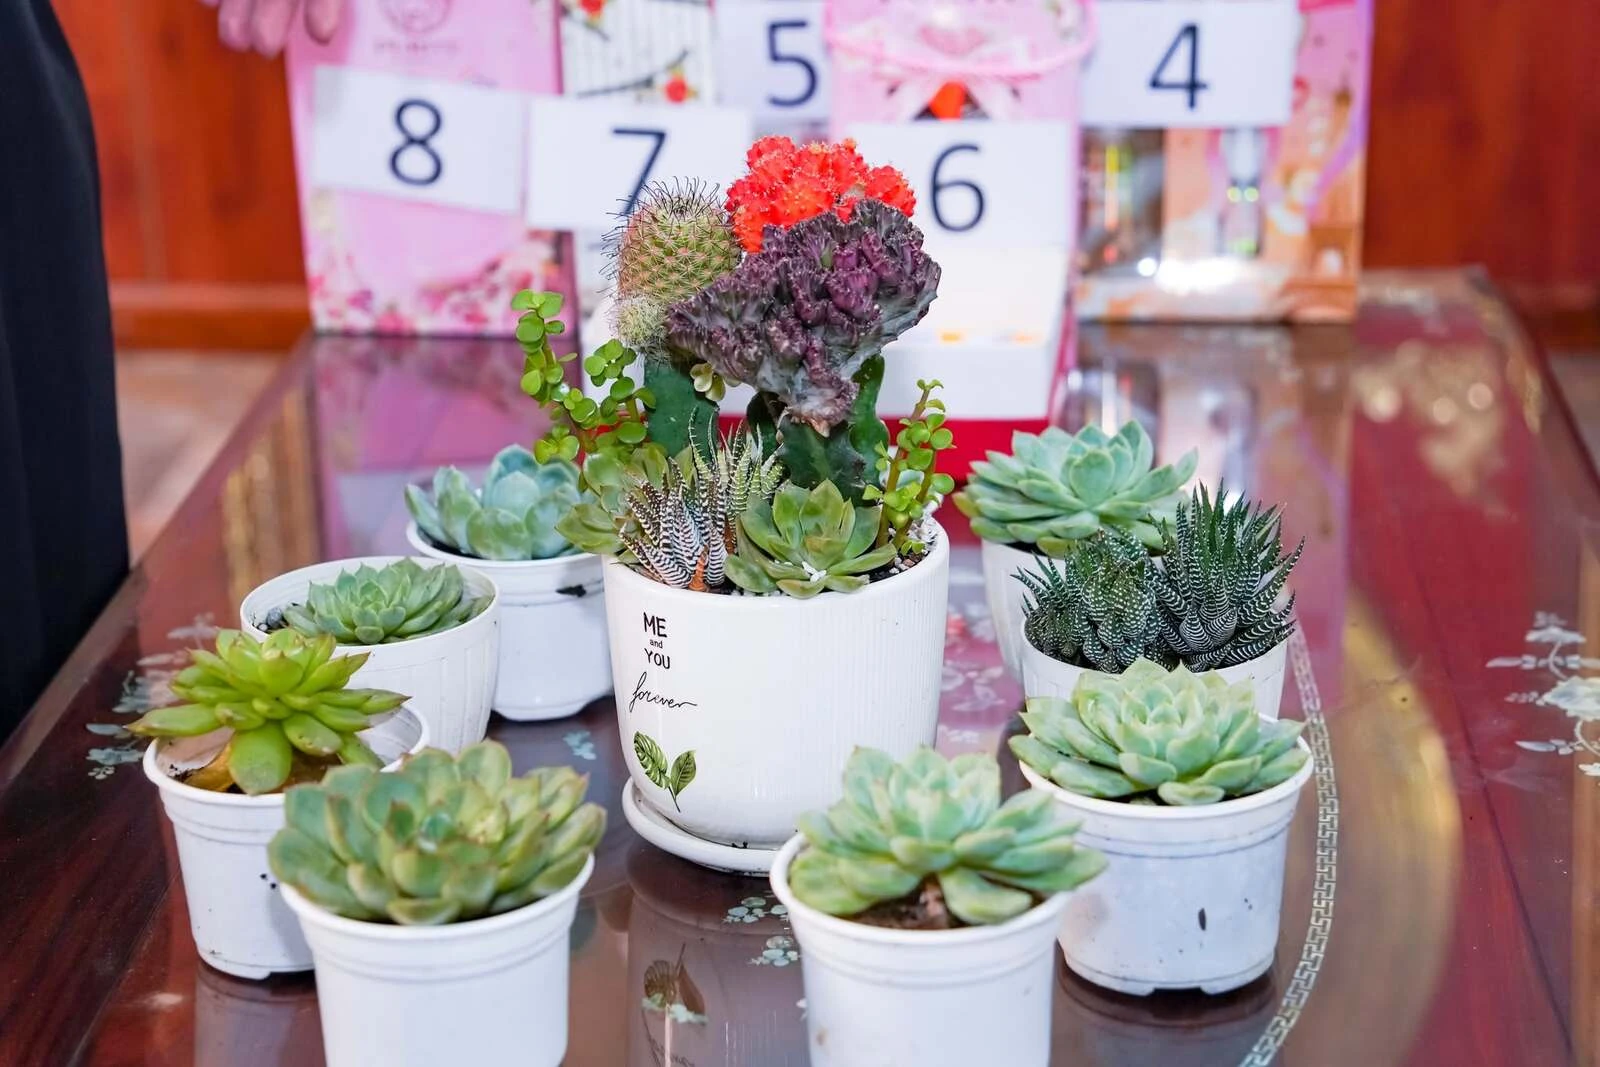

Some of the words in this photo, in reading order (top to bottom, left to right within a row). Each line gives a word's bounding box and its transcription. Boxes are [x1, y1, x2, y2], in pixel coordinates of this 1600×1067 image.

[767, 20, 819, 108] 5
[1149, 23, 1208, 110] 4
[389, 99, 443, 186] 8
[611, 128, 667, 215] 7
[929, 143, 986, 232] 6
[643, 612, 667, 638] ME
[644, 648, 671, 670] YOU
[649, 639, 663, 649] and
[628, 671, 698, 713] forever
